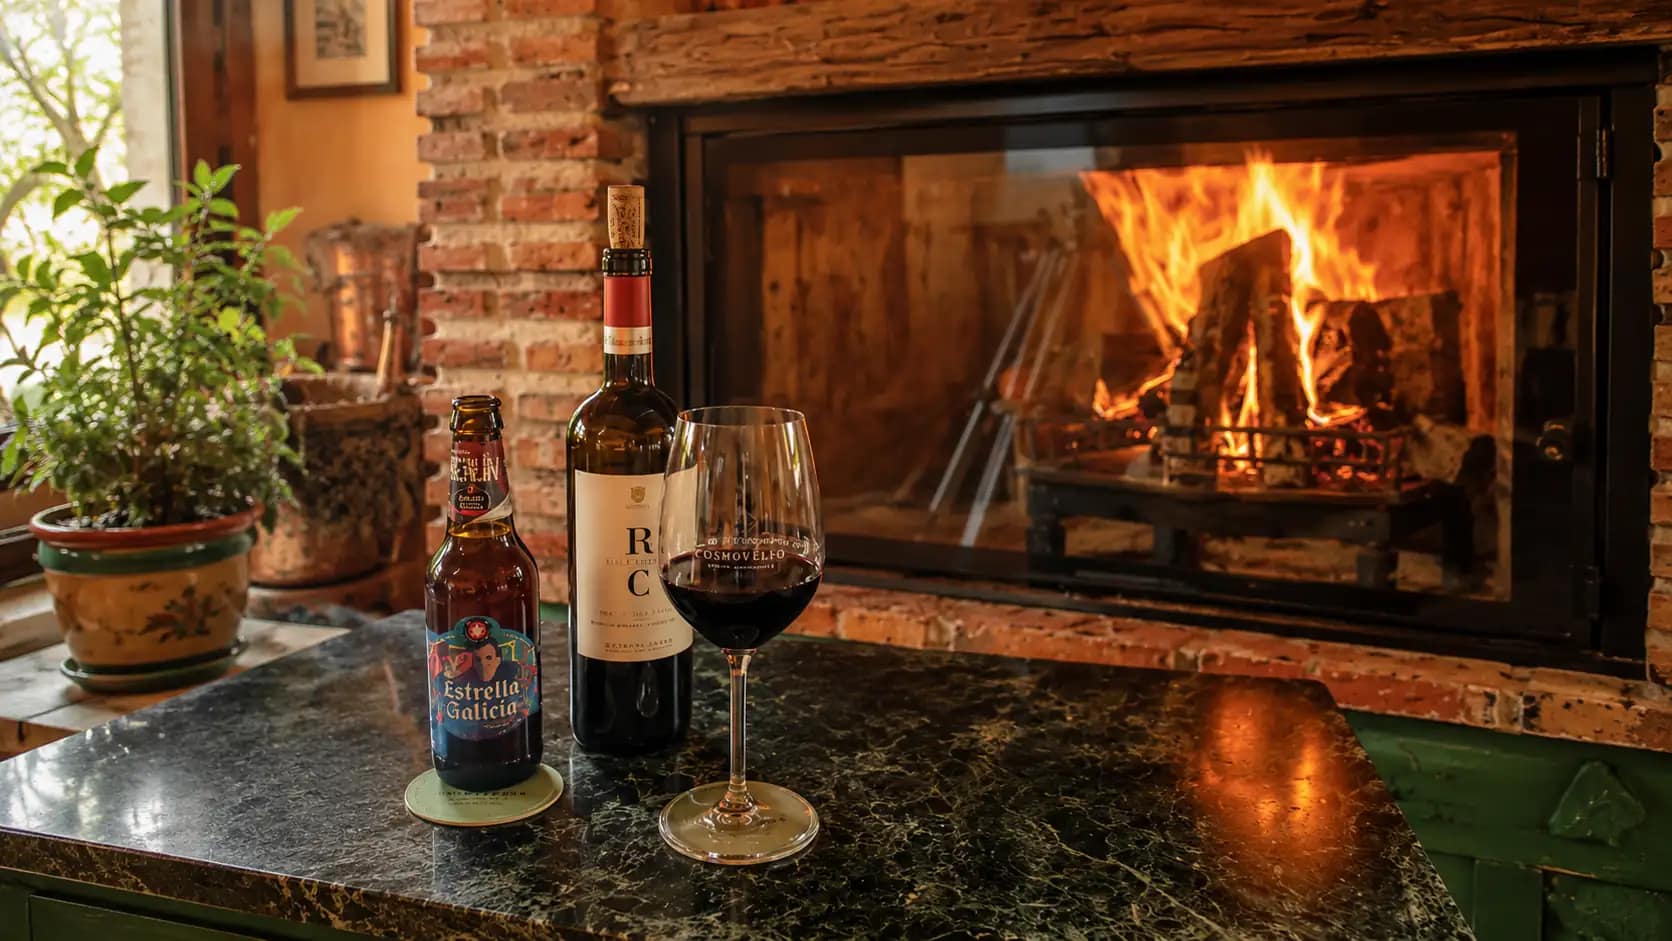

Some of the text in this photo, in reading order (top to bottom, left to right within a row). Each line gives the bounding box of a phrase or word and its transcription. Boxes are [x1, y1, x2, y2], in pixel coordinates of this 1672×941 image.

[625, 527, 654, 555] R
[627, 569, 650, 597] C
[444, 680, 520, 700] Estrella
[446, 698, 518, 722] Galicia
